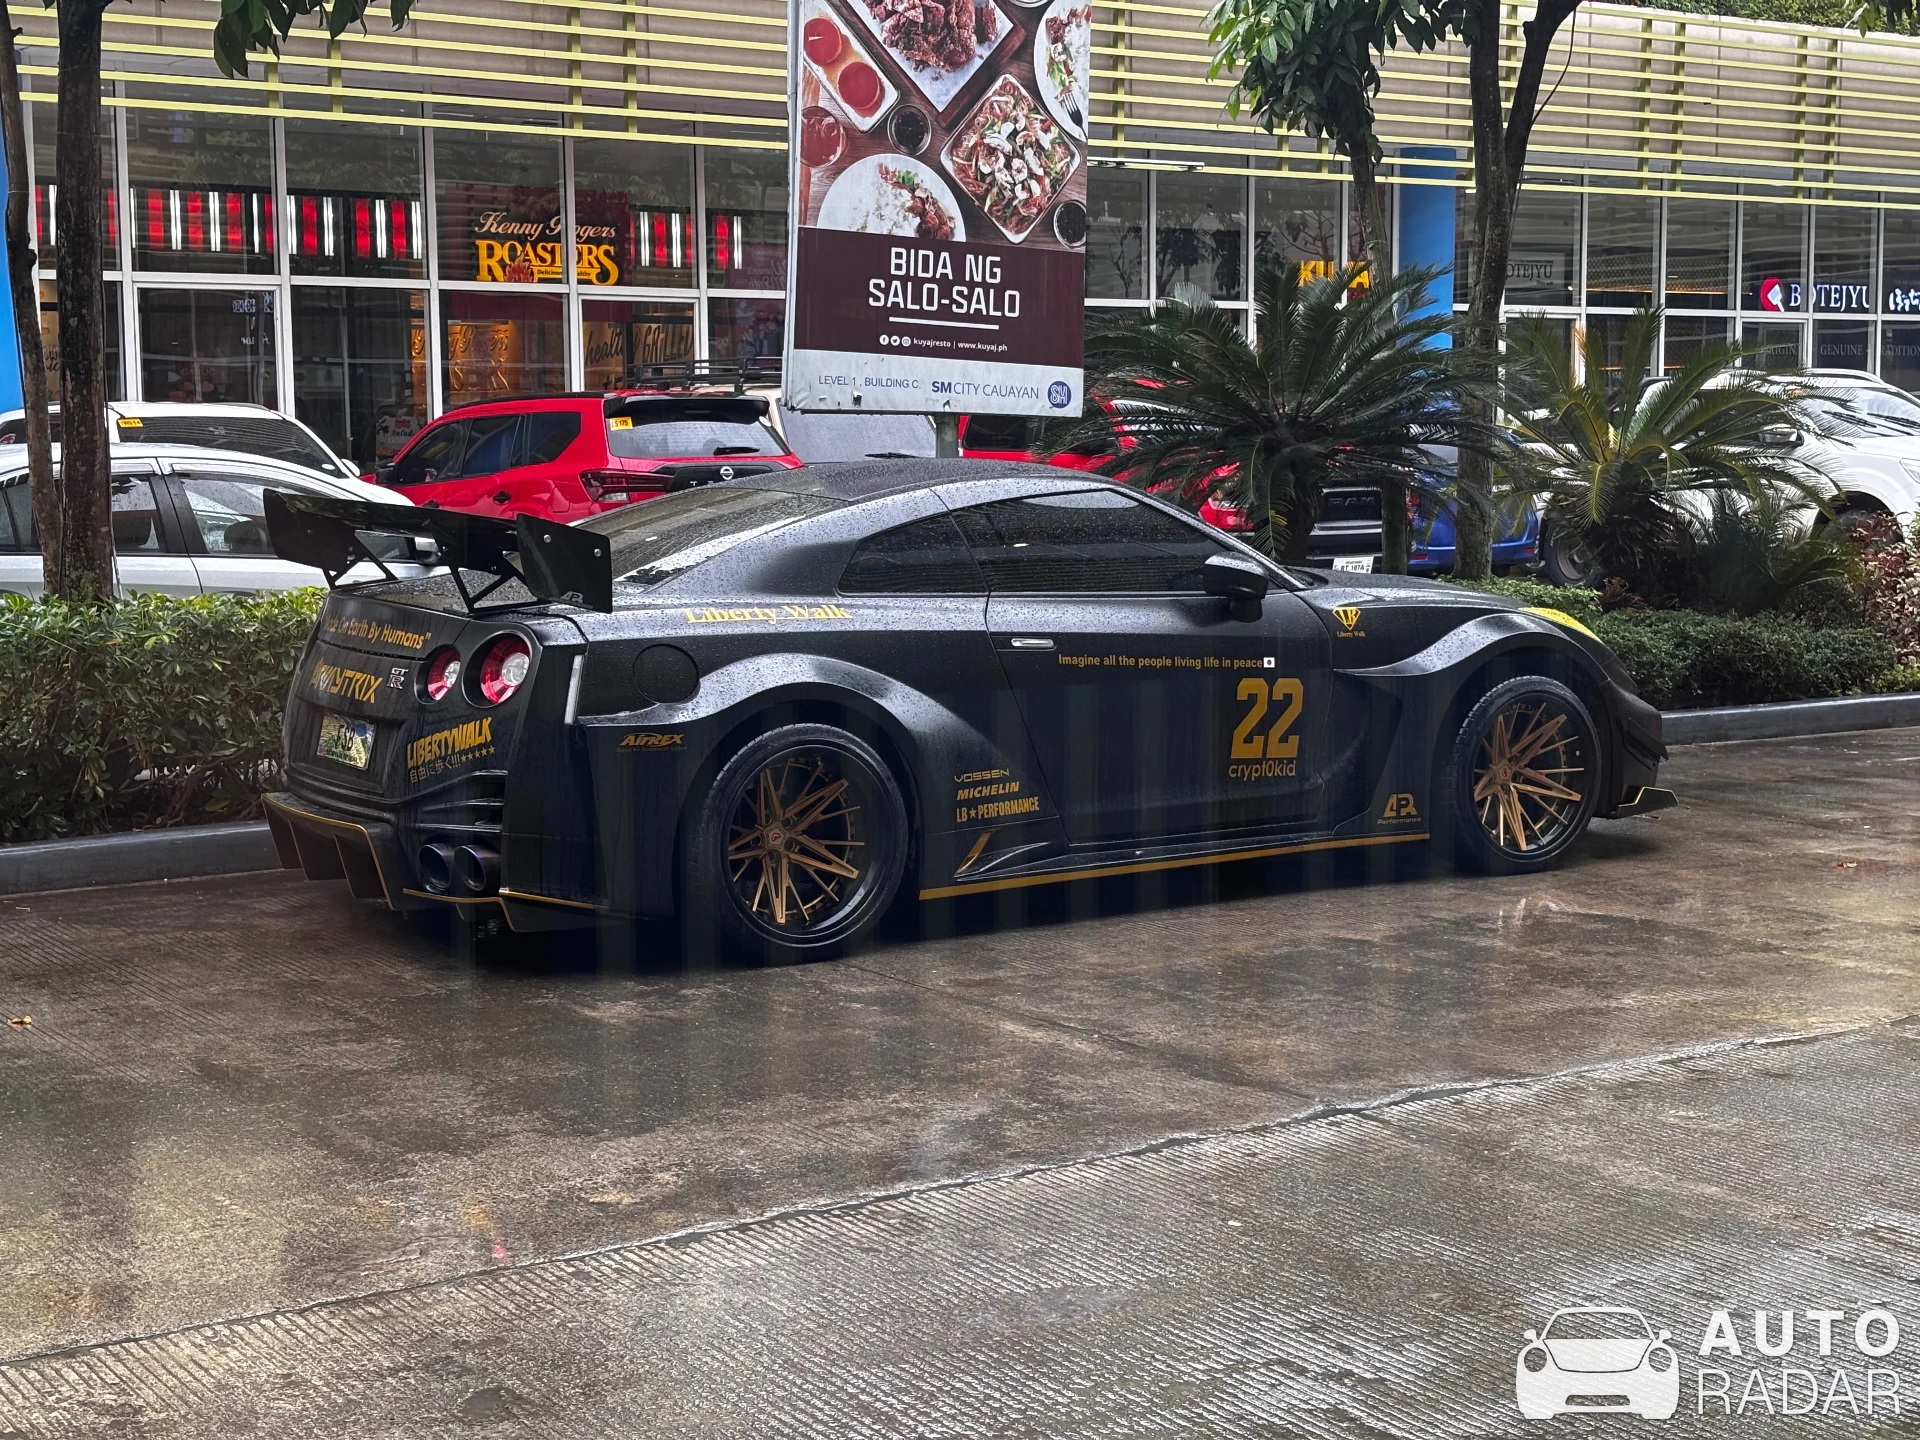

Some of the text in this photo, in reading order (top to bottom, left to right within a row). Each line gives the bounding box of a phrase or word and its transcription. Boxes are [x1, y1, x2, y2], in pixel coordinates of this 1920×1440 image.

[475, 211, 544, 240] Kenny
[890, 247, 1001, 284] BIDA NG
[1506, 262, 1554, 281] OTEJYU
[868, 278, 1020, 318] SALO-SALO
[913, 337, 1008, 352] kuyajresto www.kuyaj.ph
[1820, 344, 1864, 356] GENUINE
[818, 375, 849, 386] LEVEL
[864, 377, 909, 389] BUILDING
[982, 384, 1039, 400] CAUAYAN
[684, 605, 853, 625] Liberty Walk
[347, 617, 369, 637] Earth
[368, 621, 382, 643] By
[1058, 653, 1263, 669] Imagine all the people living life in peace
[1230, 677, 1304, 759] 22
[407, 716, 492, 770] LIBERTYWALK
[954, 768, 1010, 783] VOSSEN
[956, 781, 1020, 800] MICHELIN
[1376, 817, 1422, 825] Performance
